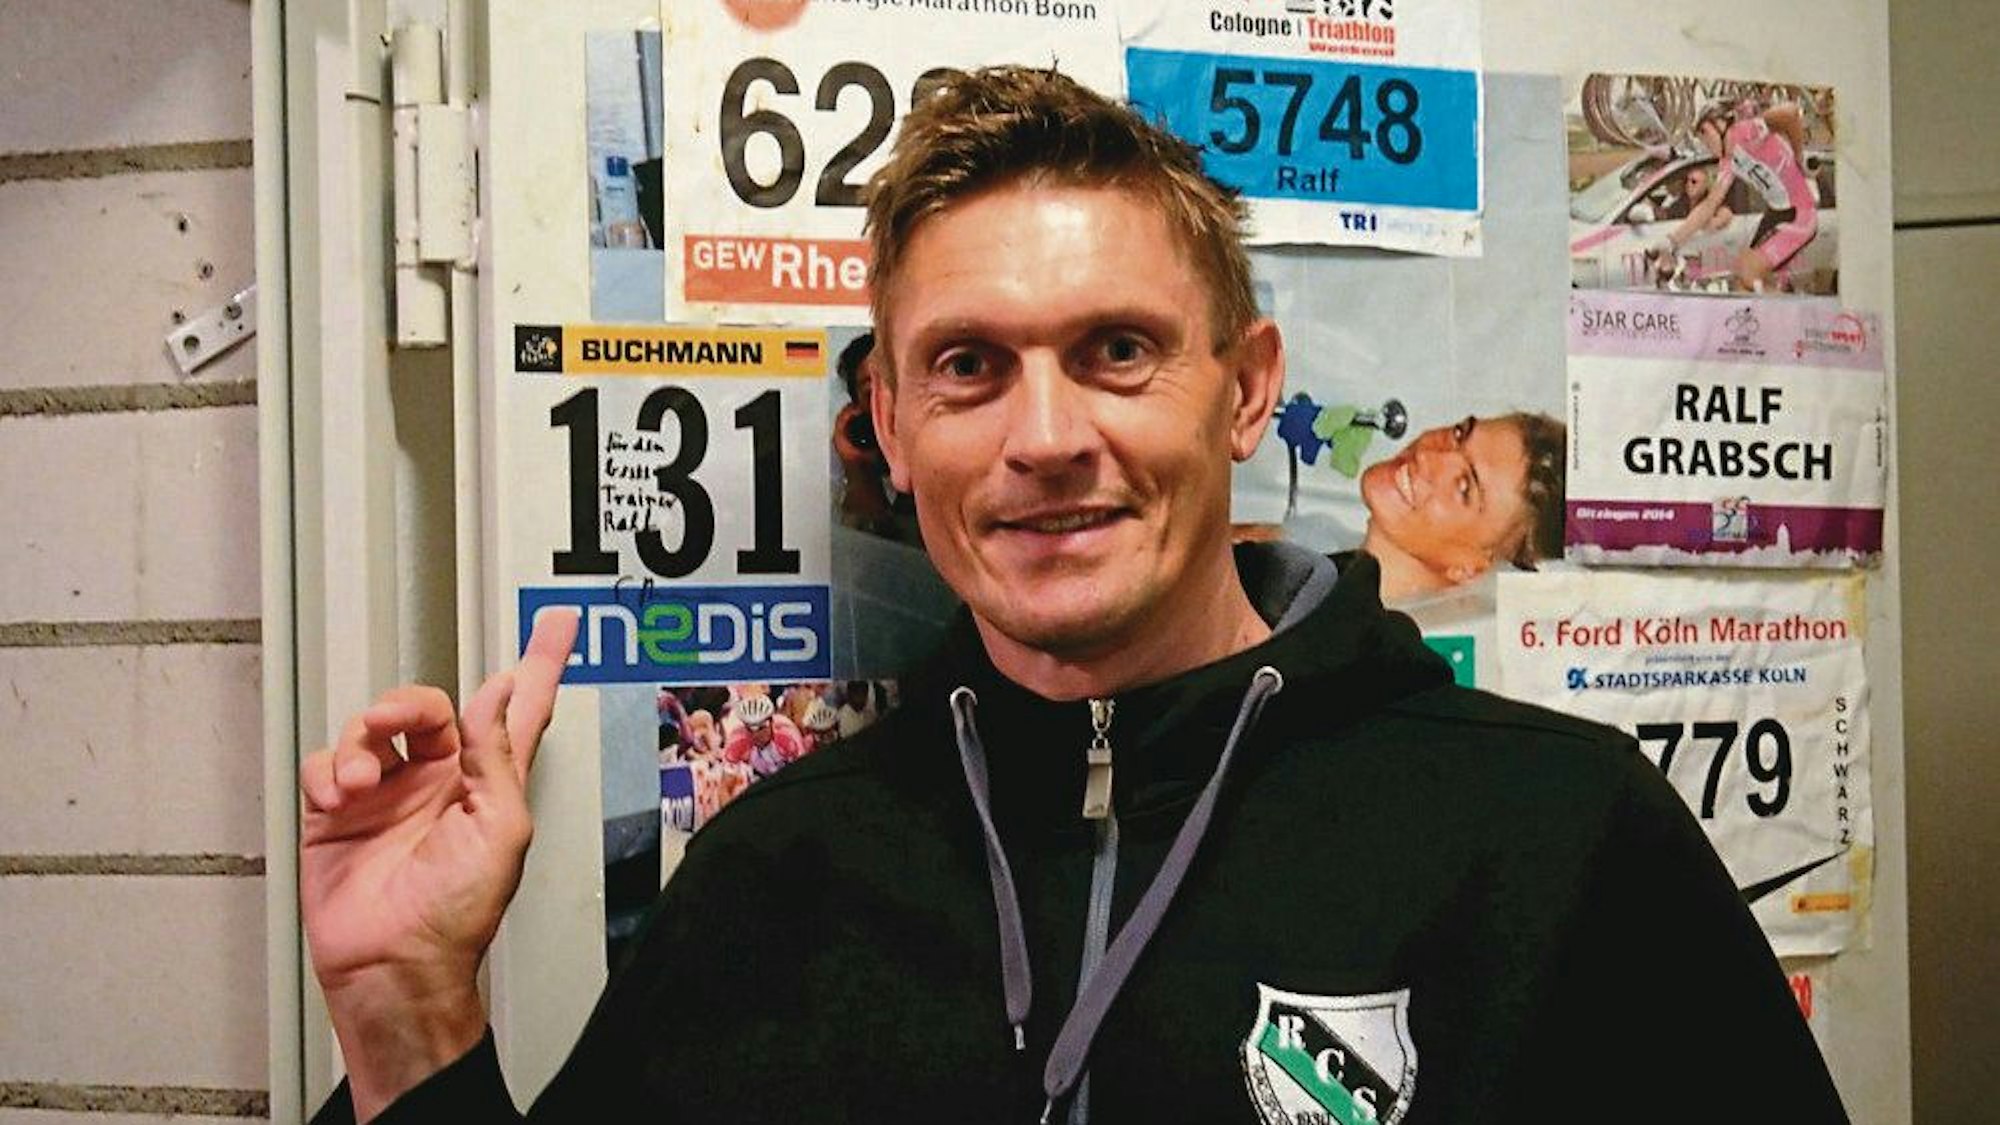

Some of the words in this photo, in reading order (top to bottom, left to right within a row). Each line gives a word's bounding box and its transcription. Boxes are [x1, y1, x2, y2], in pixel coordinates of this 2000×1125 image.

[1036, 0, 1096, 19] Bonn
[1210, 10, 1292, 36] Cologne
[1308, 17, 1395, 44] Triathlon
[719, 56, 964, 208] 62
[1209, 67, 1423, 166] 5748
[1276, 165, 1340, 194] Ralf
[1340, 212, 1377, 231] TRI
[692, 240, 768, 271] GEW
[771, 242, 868, 291] Rhe
[1583, 309, 1627, 330] STAR
[1633, 312, 1680, 333] CARE
[582, 339, 763, 365] BUCHMANN
[1674, 384, 1782, 424] RALF
[1623, 437, 1832, 480] GRABSCH
[551, 385, 801, 579] 131
[1520, 620, 1545, 648] 6.
[1556, 618, 1623, 646] Ford
[1635, 617, 1698, 645] Köln
[1710, 615, 1847, 642] Marathon
[1595, 668, 1750, 688] STADTSPARKASSE
[1833, 697, 1852, 845] SCHWARZ
